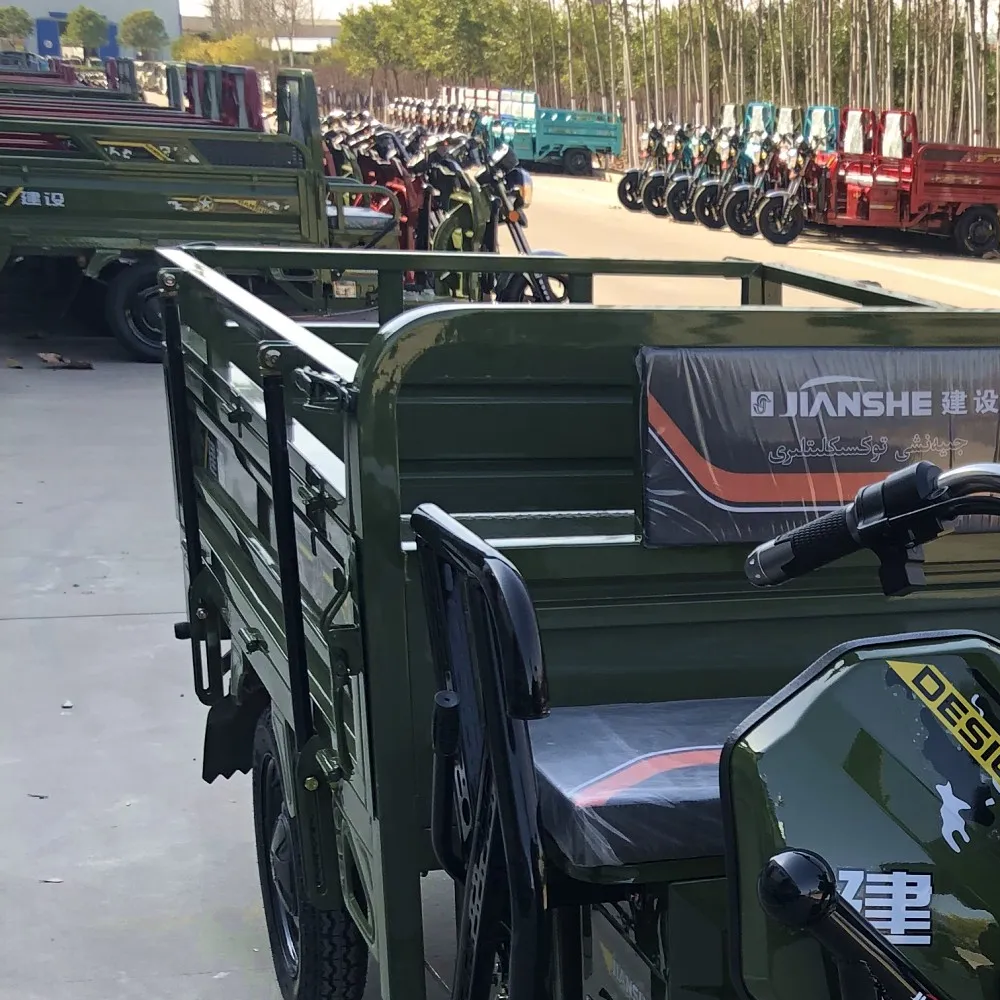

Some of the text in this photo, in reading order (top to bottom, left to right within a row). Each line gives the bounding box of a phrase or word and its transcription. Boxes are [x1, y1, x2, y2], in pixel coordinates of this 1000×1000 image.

[20, 191, 65, 208] 建设
[779, 389, 999, 417] JIANSHE 建设
